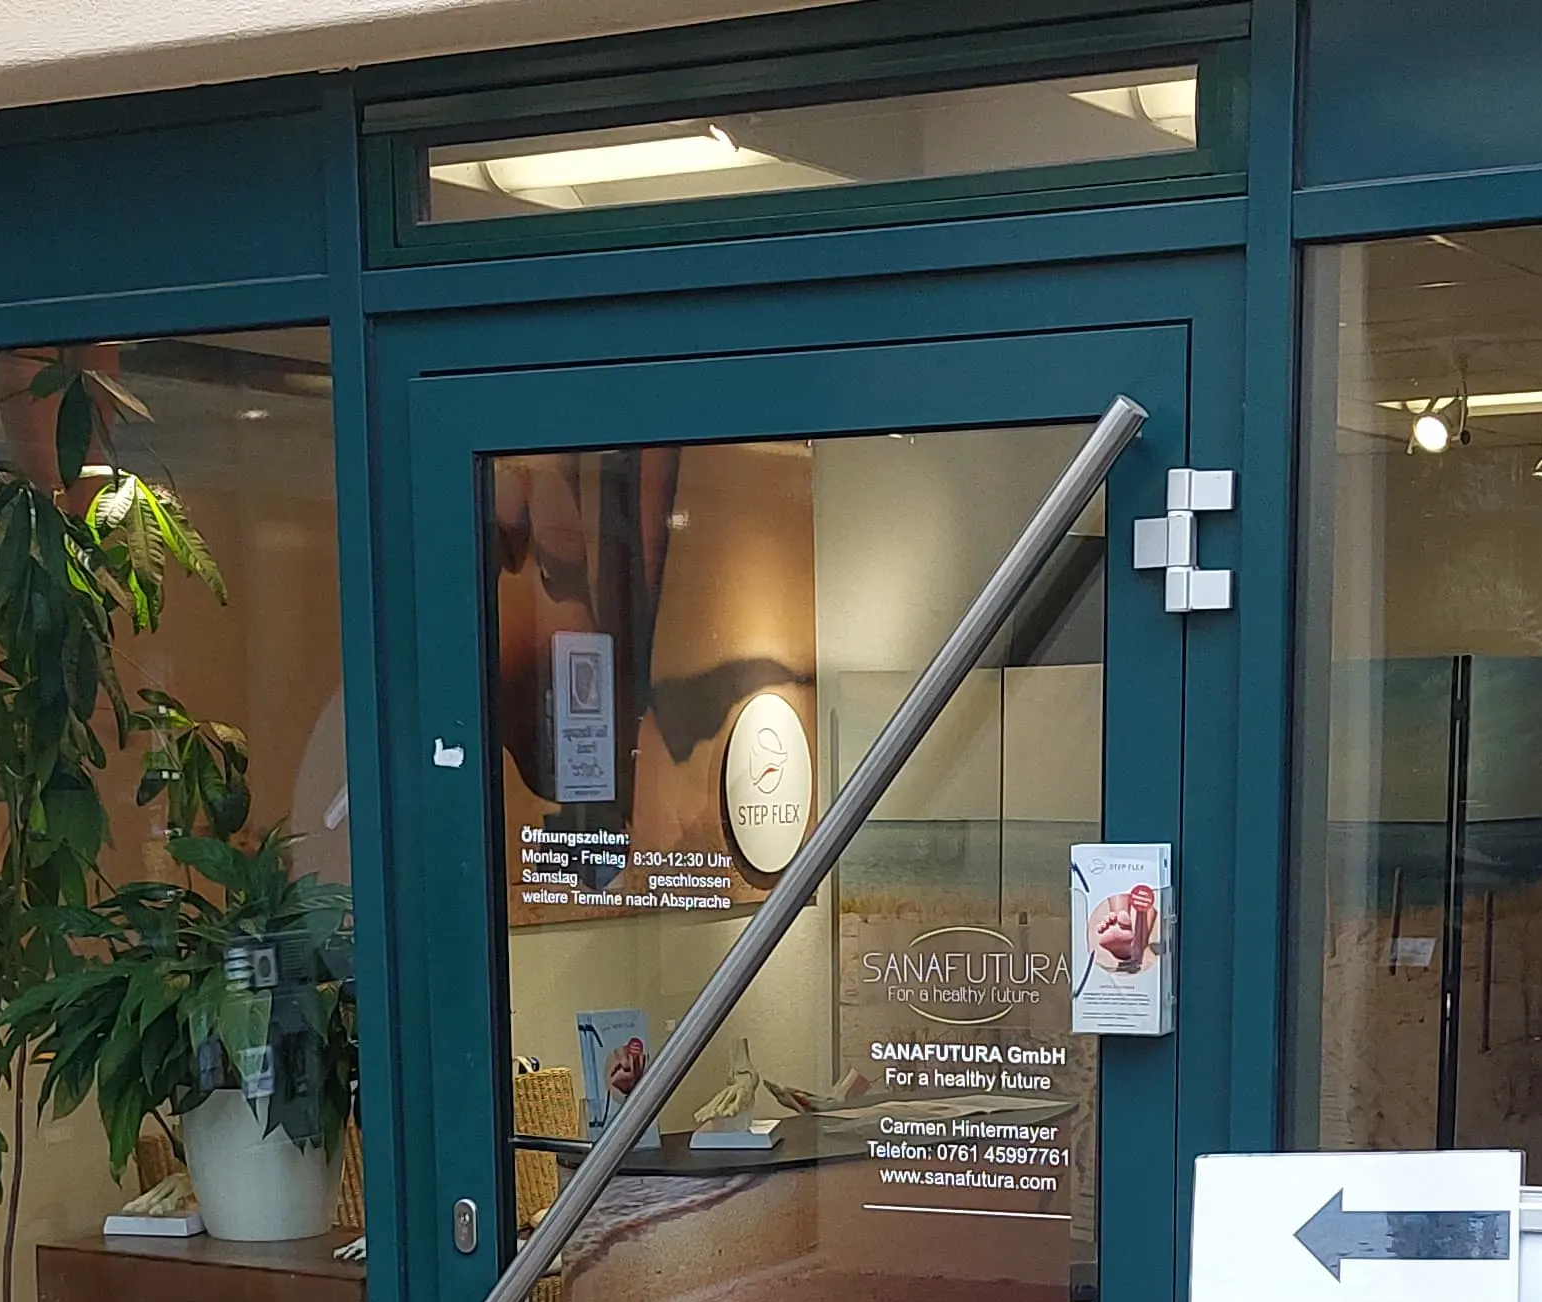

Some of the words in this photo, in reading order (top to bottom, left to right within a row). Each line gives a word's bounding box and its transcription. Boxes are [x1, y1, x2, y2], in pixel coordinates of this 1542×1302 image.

[738, 804, 769, 826] STEP
[772, 803, 800, 825] FLEX
[521, 826, 630, 847] Öffnungszeiten:
[521, 849, 569, 867] Montag
[581, 850, 626, 868] Freitag
[633, 851, 704, 867] 8:30-12:30
[707, 852, 733, 868] Uhr
[522, 868, 578, 887] Samstag
[648, 873, 731, 890] geschlossen
[521, 889, 568, 904] weitere
[571, 890, 622, 906] Termine
[625, 891, 657, 907] nach
[660, 893, 731, 911] Absprache
[862, 952, 1072, 985] SANAFUTURA
[887, 985, 915, 1002] For
[919, 989, 929, 1002] a
[933, 985, 986, 1006] healthy
[991, 986, 1041, 1004] future
[870, 1042, 1003, 1064] SANAFUTURA
[1007, 1046, 1066, 1066] GmbH
[885, 1067, 914, 1086] For
[918, 1072, 929, 1086] a
[934, 1069, 996, 1092] healthy
[1000, 1071, 1052, 1090] future
[880, 1117, 947, 1137] Carmen
[952, 1120, 1059, 1144] Hintermayer
[866, 1140, 932, 1161] Telefon:
[936, 1143, 978, 1163] 0761
[983, 1145, 1071, 1167] 45997761
[879, 1168, 1057, 1191] www.sanafutura.com
